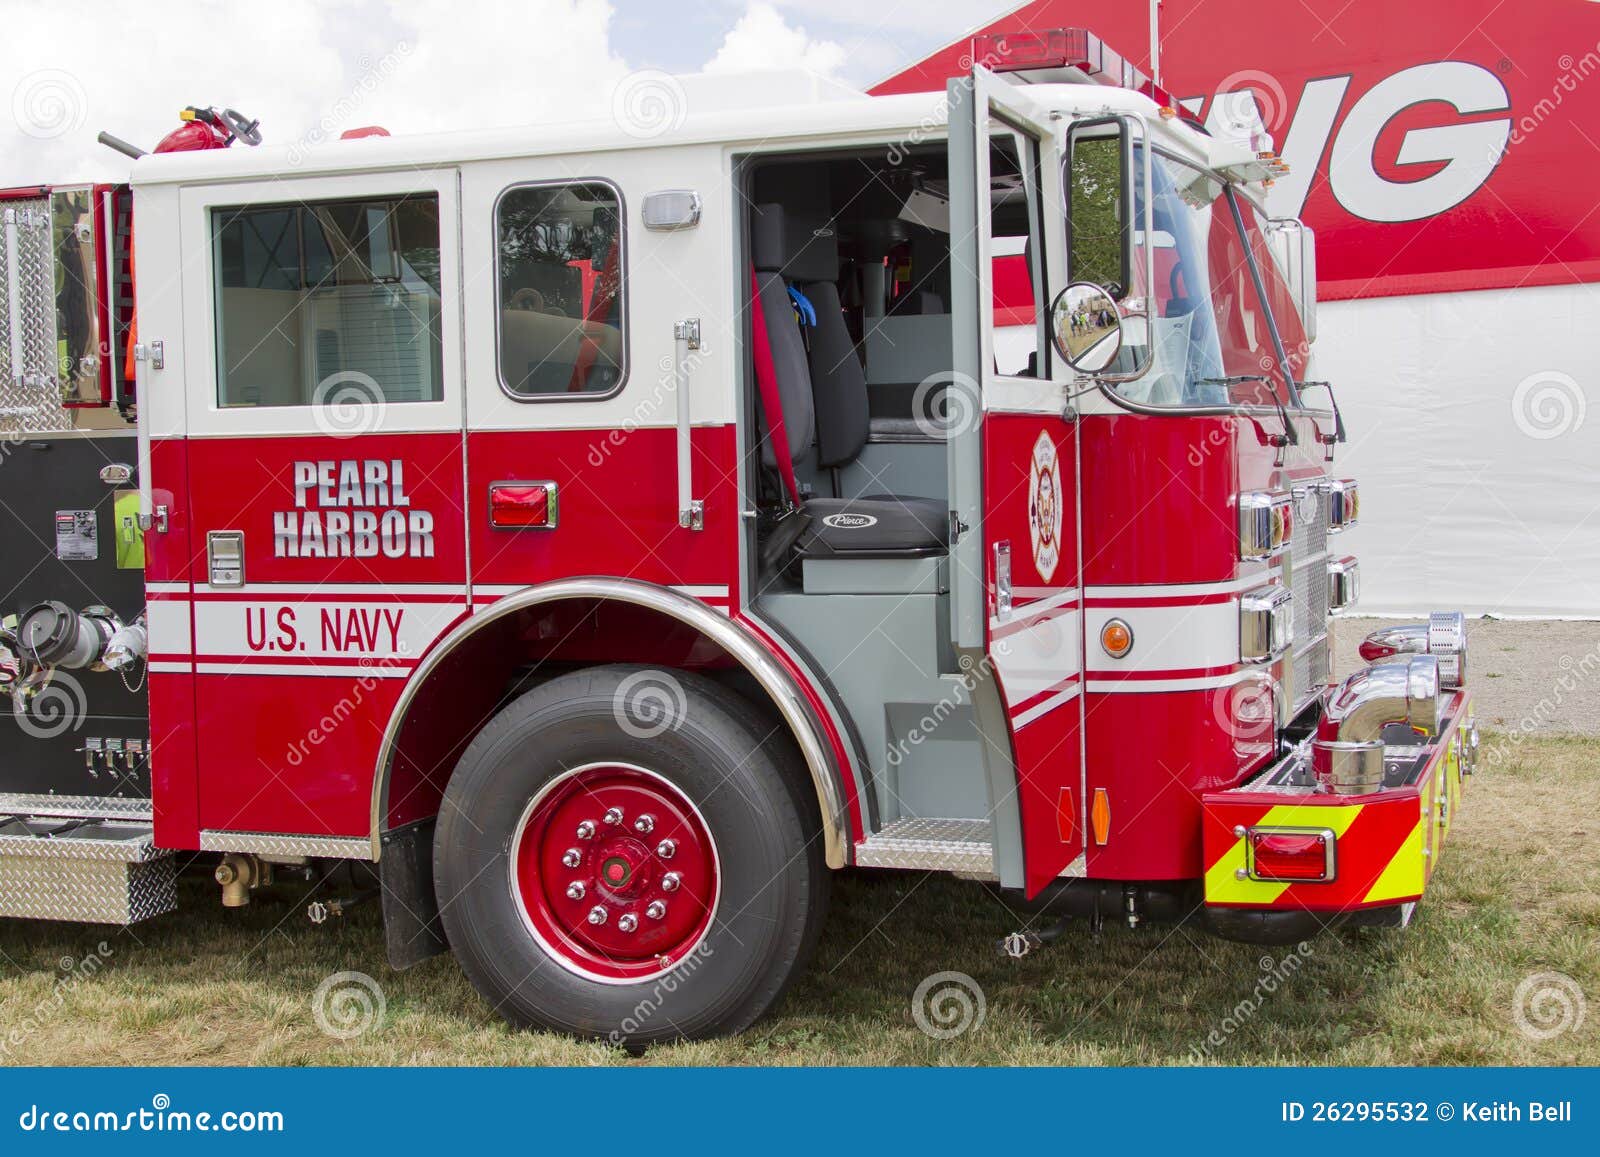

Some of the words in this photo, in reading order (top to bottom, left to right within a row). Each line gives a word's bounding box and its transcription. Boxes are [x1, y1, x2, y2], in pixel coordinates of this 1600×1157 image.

[294, 459, 410, 507] PEARL
[273, 510, 435, 558] HARBOR
[246, 607, 305, 651] U.S.
[320, 608, 403, 653] NAVY
